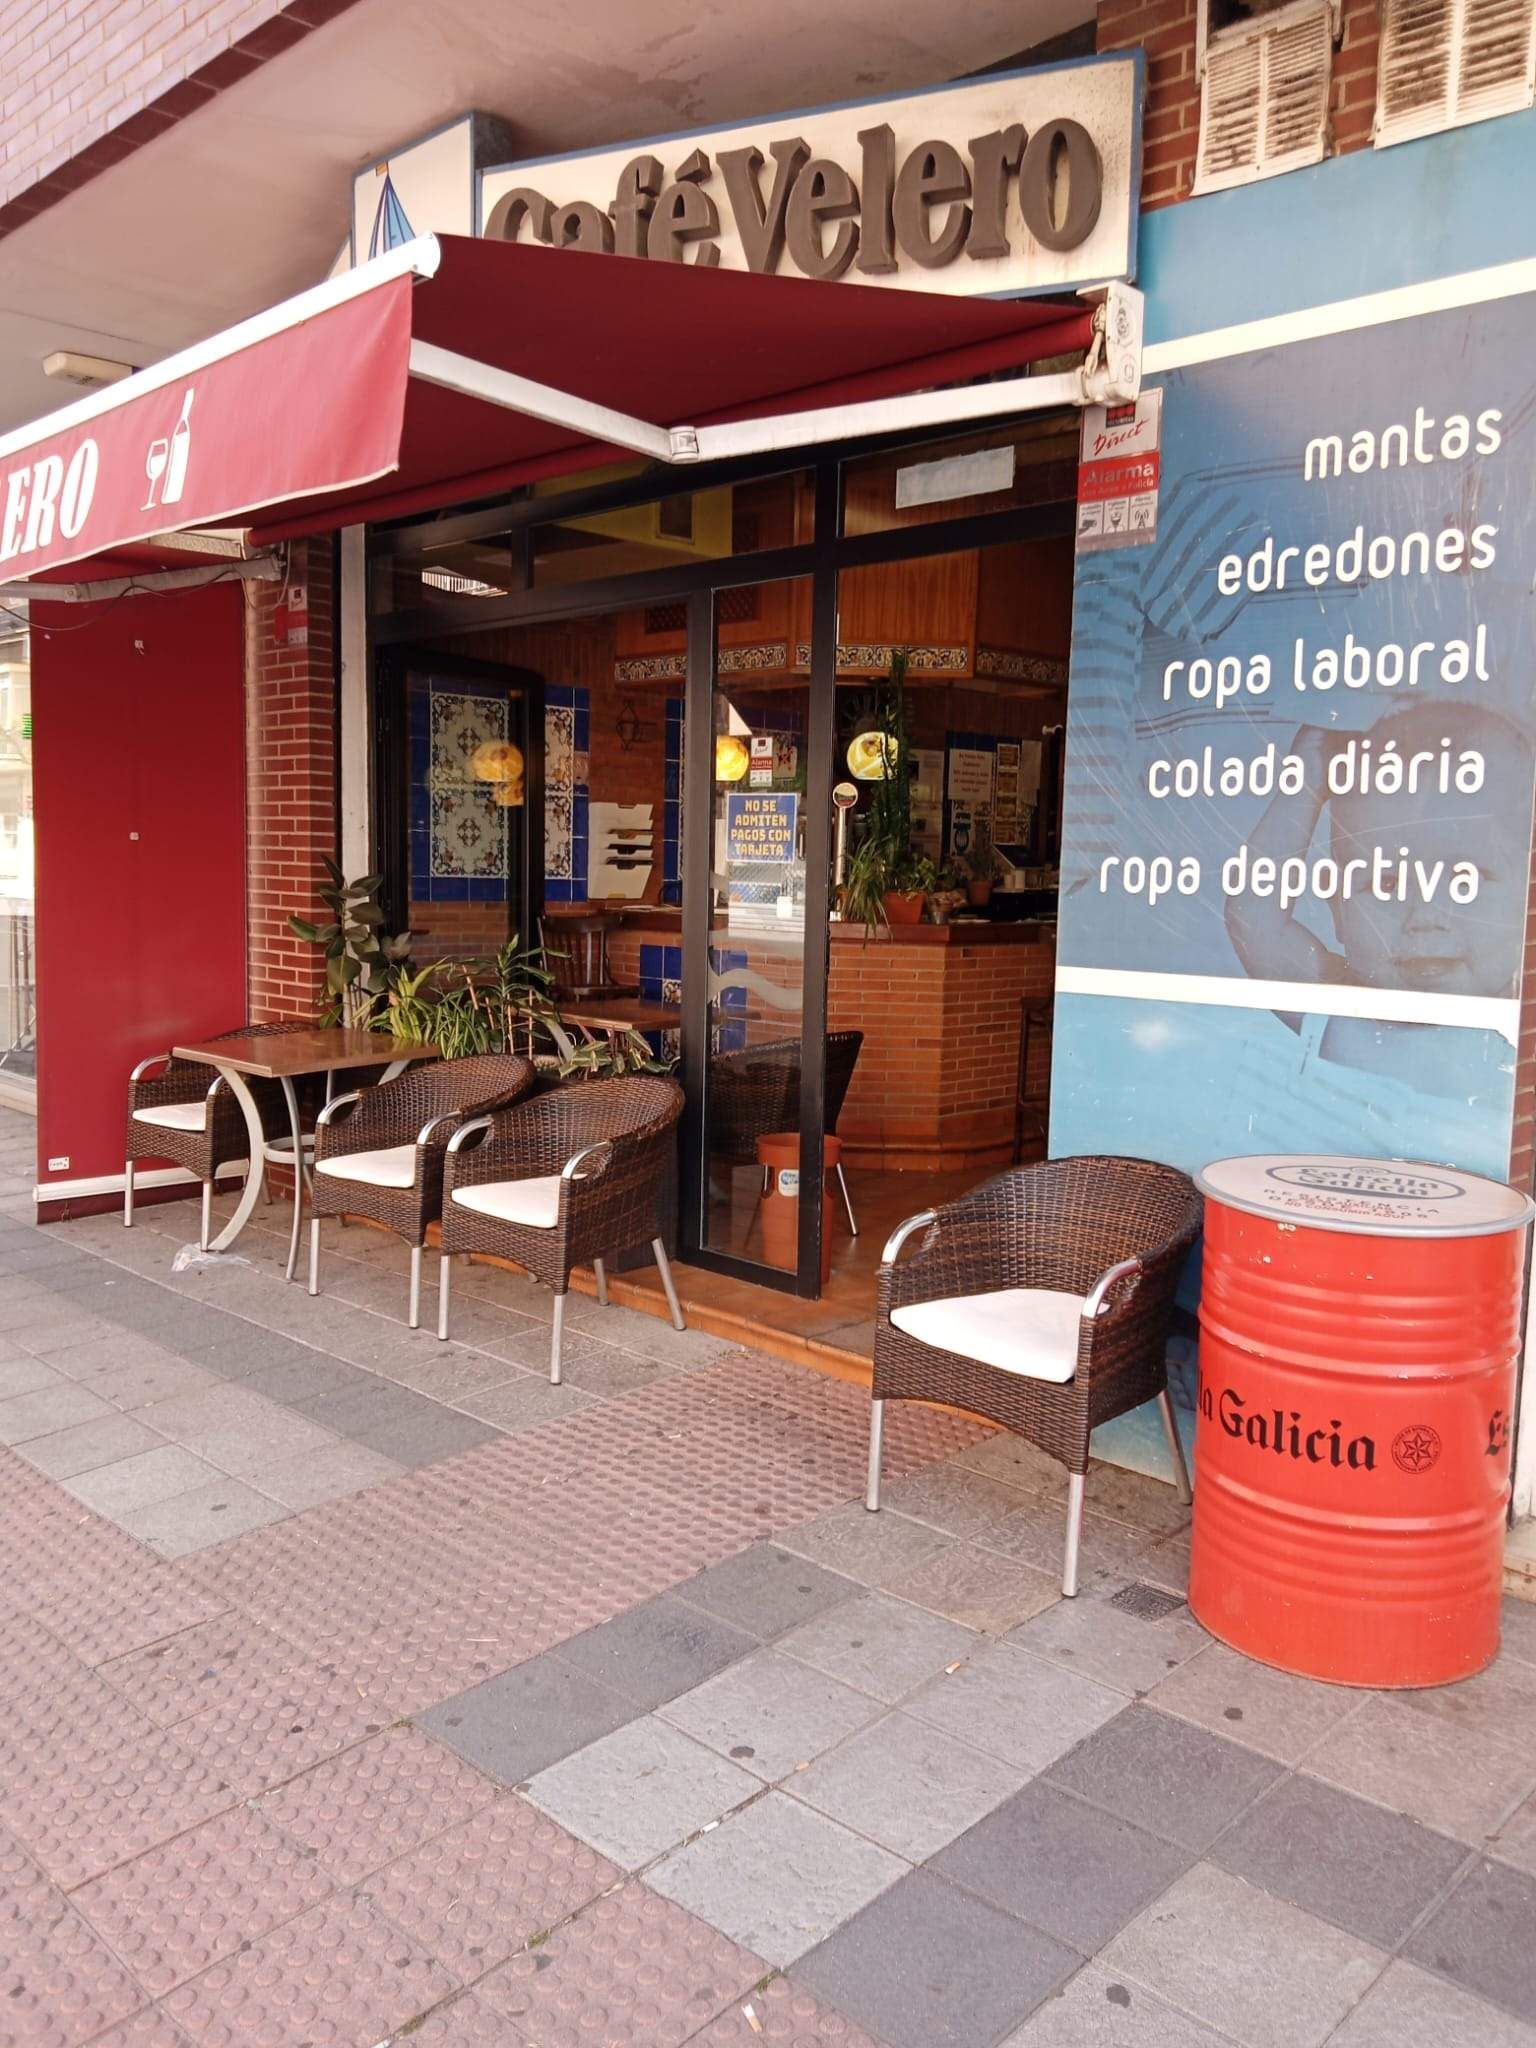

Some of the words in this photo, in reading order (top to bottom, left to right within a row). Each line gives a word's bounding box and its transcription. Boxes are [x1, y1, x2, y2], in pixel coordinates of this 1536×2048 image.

[716, 118, 1101, 279] Velero
[1304, 406, 1503, 481] mantas
[1218, 525, 1499, 595] edredones
[1163, 654, 1271, 709] ropa
[1293, 624, 1490, 692] laboral
[1148, 743, 1305, 798] colada
[1327, 737, 1485, 795] diária
[731, 829, 766, 841] PAGOS
[768, 829, 791, 842] CON
[735, 814, 787, 827] ADMITEN
[745, 800, 760, 812] NO
[762, 800, 777, 812] SE
[735, 843, 784, 856] TARJETA
[1100, 856, 1200, 906] ropa
[1221, 845, 1480, 910] deportiva
[1297, 1168, 1439, 1189] Estrella
[1299, 1175, 1429, 1196] Galicia
[1219, 1388, 1378, 1472] Galicia
